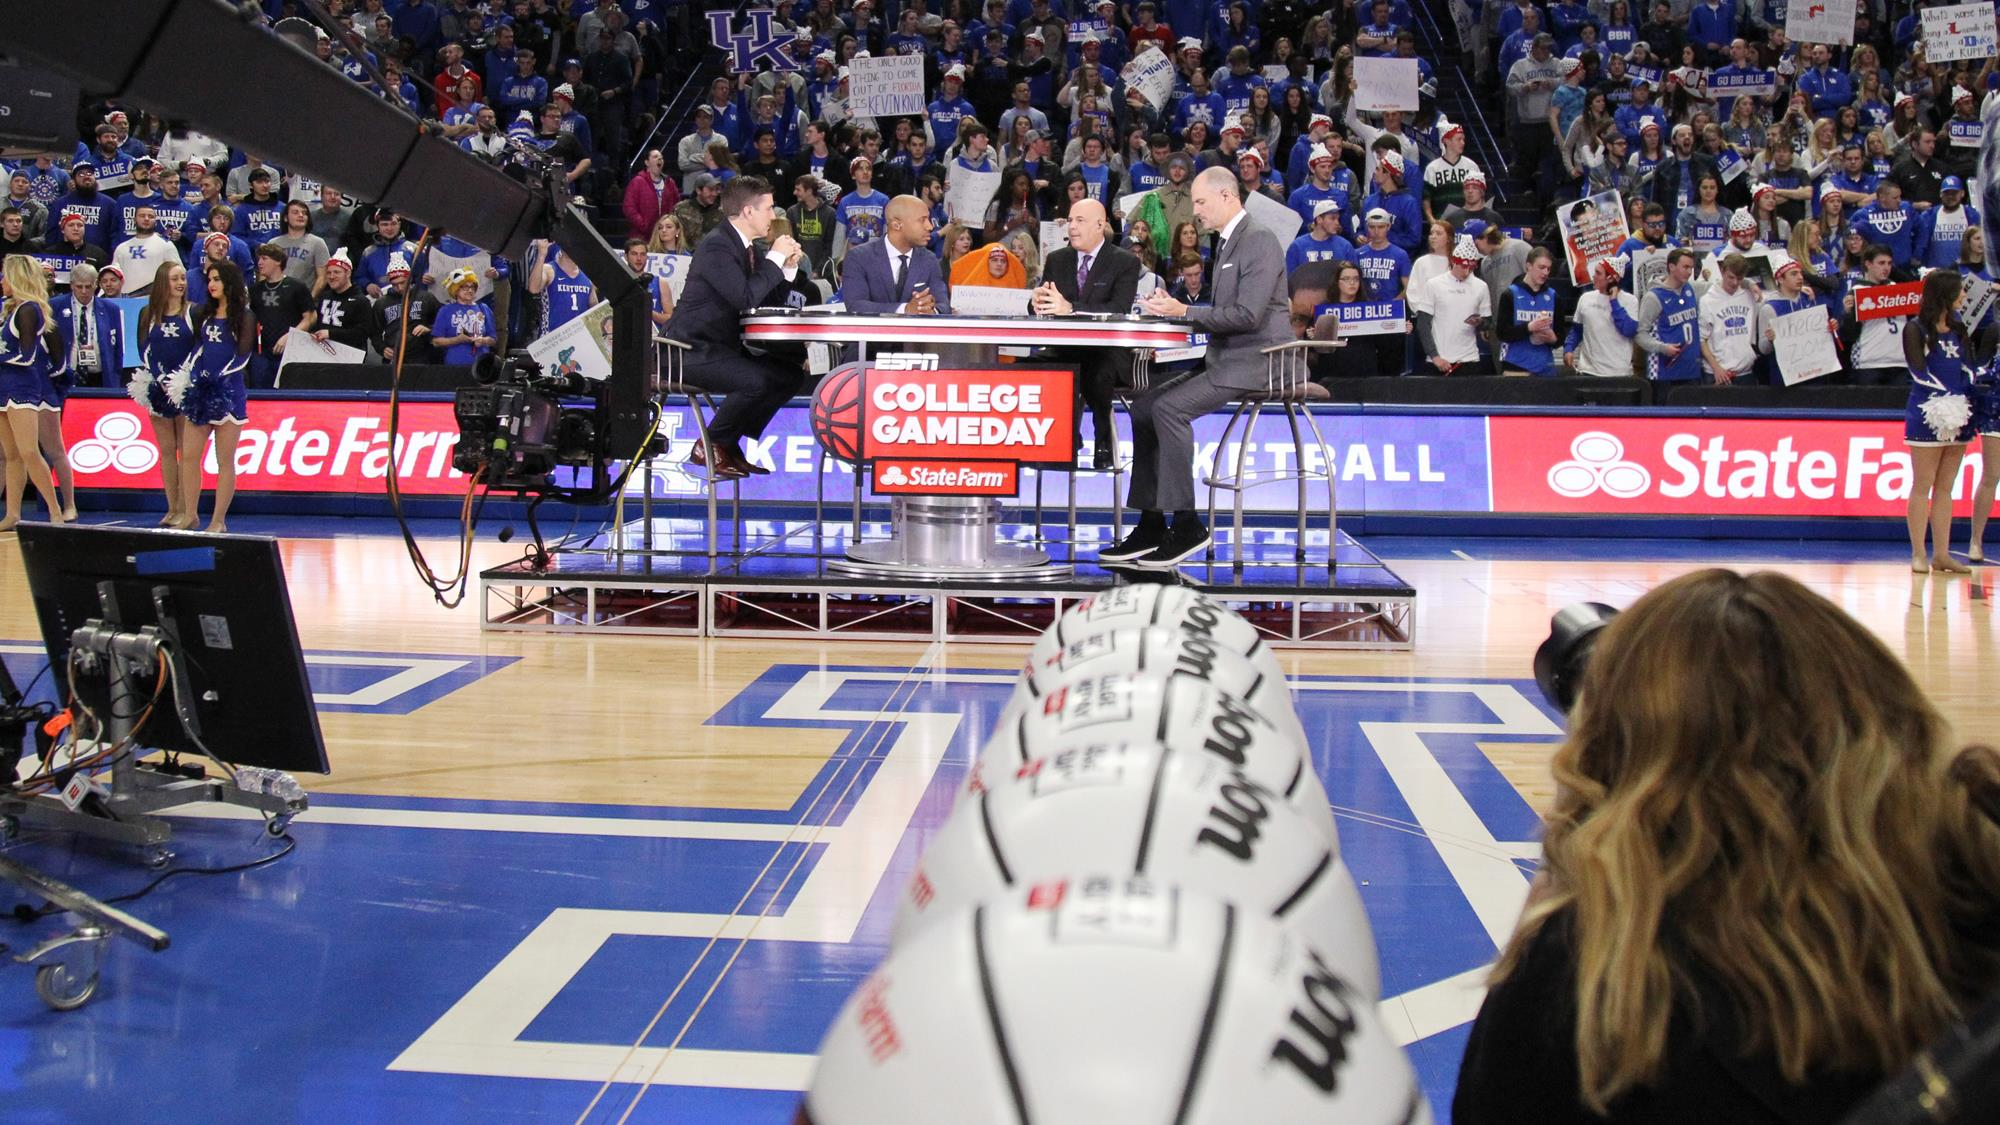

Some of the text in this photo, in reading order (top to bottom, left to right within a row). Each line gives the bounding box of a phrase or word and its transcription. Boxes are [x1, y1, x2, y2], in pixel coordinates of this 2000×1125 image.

[705, 10, 800, 73] UK
[1608, 31, 1631, 40] BBN
[853, 56, 921, 69] THE ONLY GOOD
[852, 70, 918, 84] THING TO COME
[1718, 74, 1766, 86] GO BIG BLUE
[852, 84, 872, 96] OUT
[878, 84, 890, 92] OF
[855, 94, 925, 115] IS KEVIN KNOX
[1952, 126, 1982, 136] GO BIG
[248, 212, 280, 222] WILD
[250, 221, 280, 230] CATS
[1697, 227, 1714, 238] BIG
[129, 246, 148, 259] UK
[1373, 258, 1395, 270] BLUE
[557, 283, 590, 294] KENTUCKY
[571, 294, 578, 310] 1
[320, 300, 345, 326] UK
[1344, 306, 1362, 319] BIG
[1365, 304, 1392, 318] BLUE
[1716, 306, 1749, 320] KENTUCKY
[161, 322, 180, 338] UK
[206, 326, 222, 342] UK
[1683, 323, 1692, 344] 0
[1938, 340, 1959, 358] UK
[875, 352, 939, 371] ESPN
[872, 383, 1042, 413] COLLEGE
[871, 416, 1055, 446] GAMEDAY
